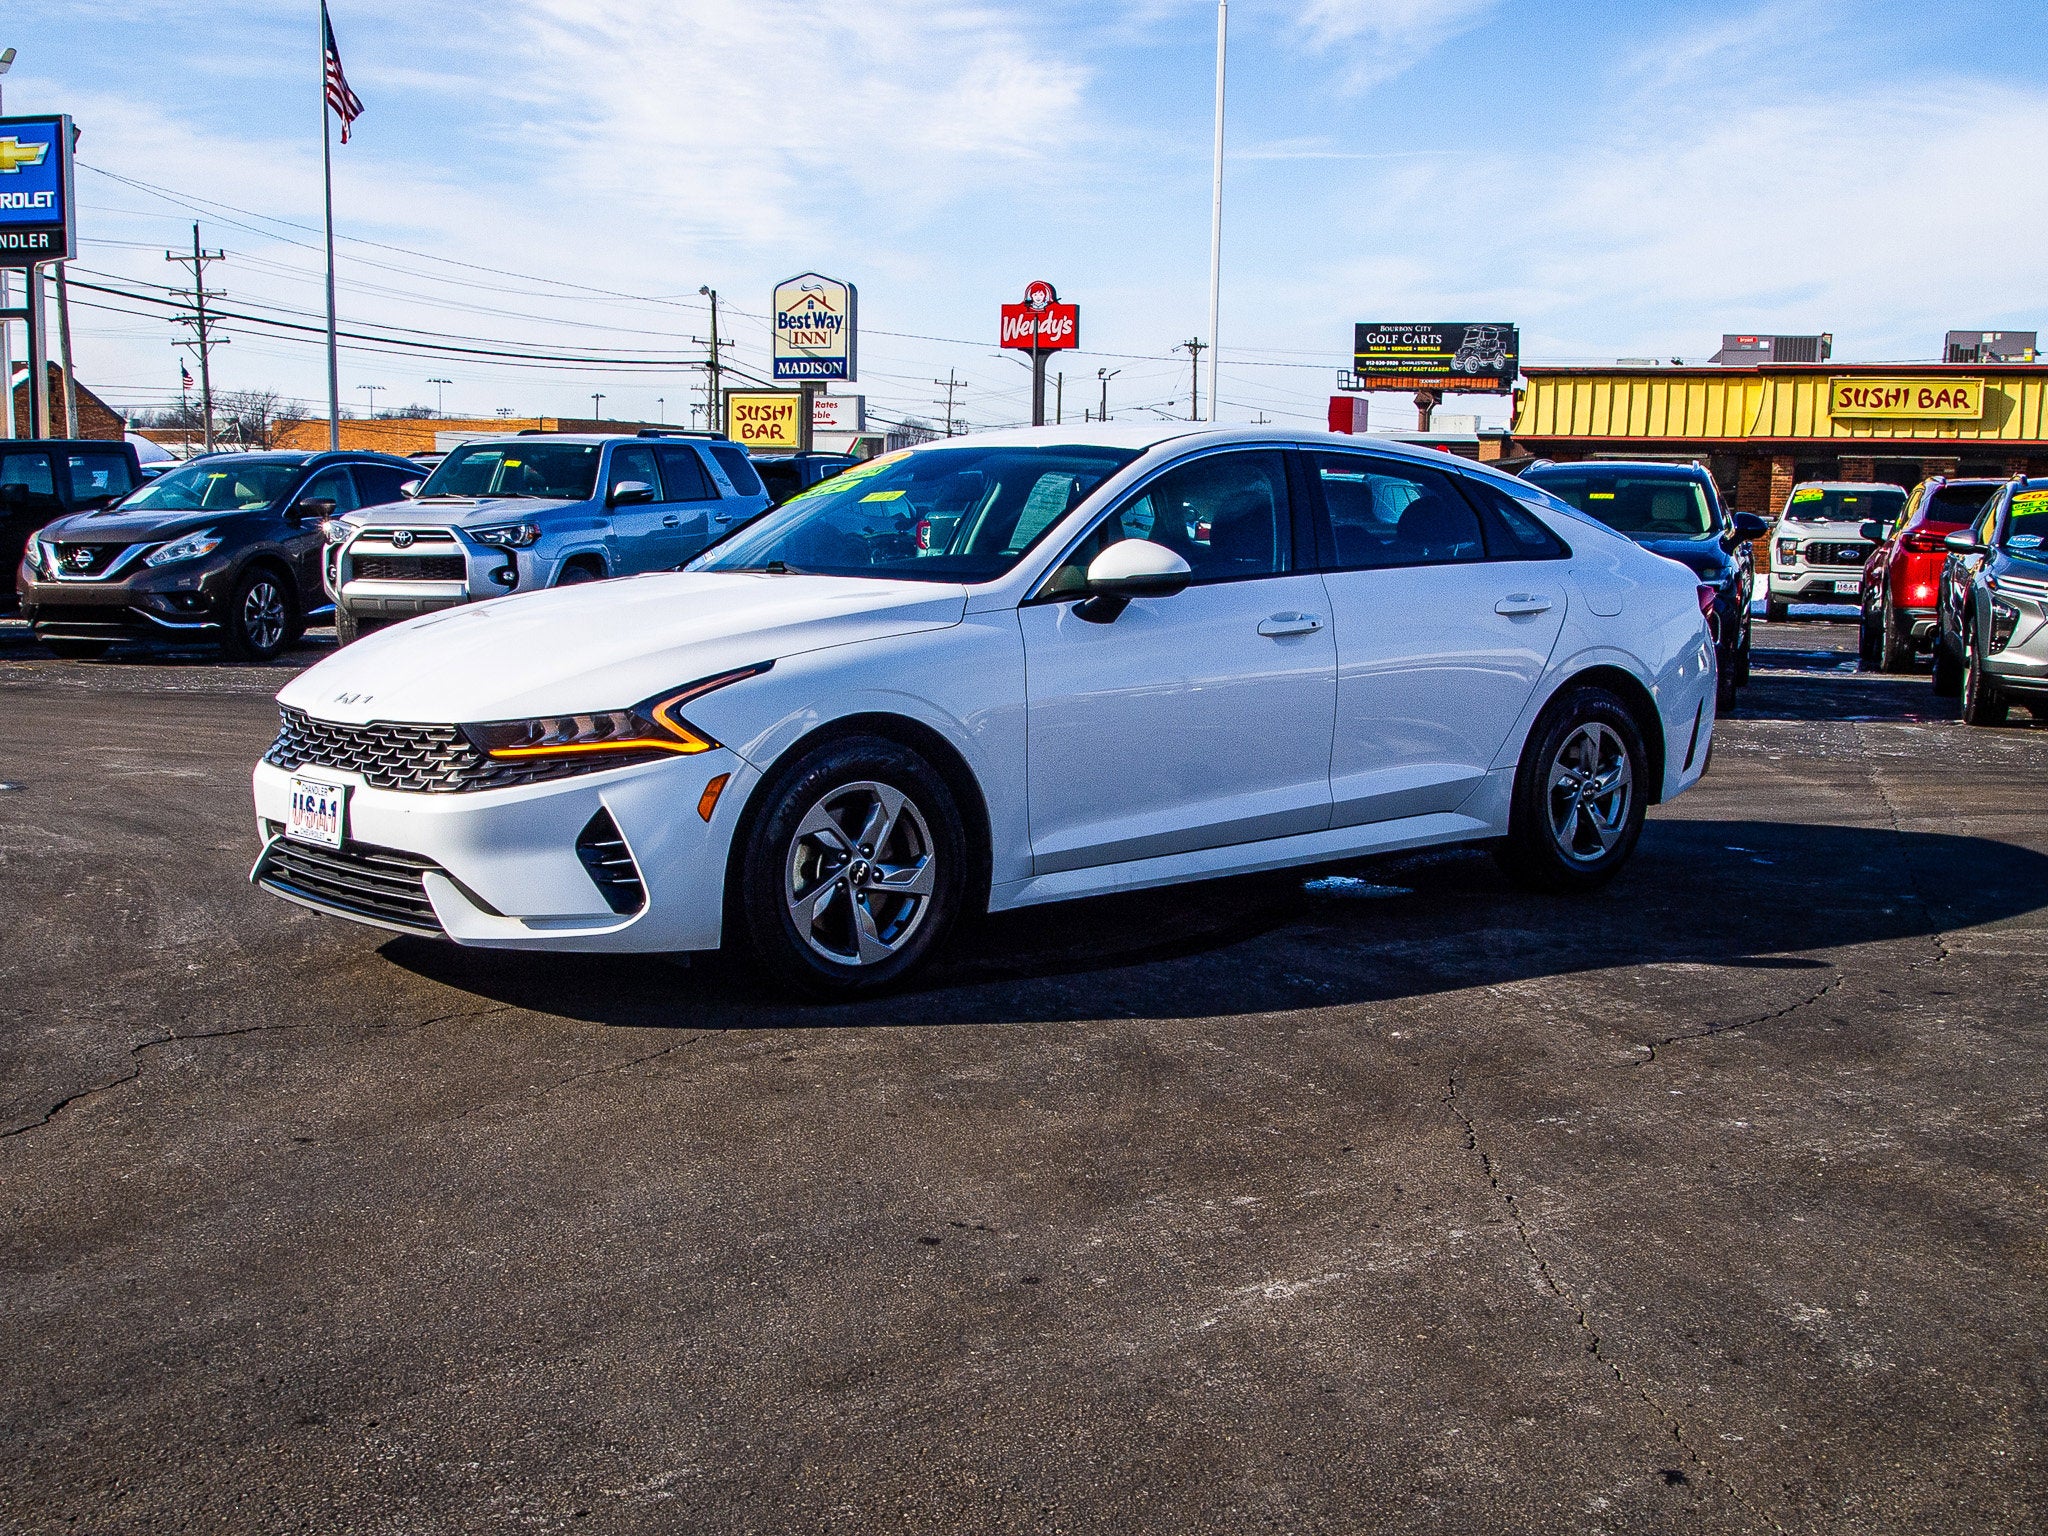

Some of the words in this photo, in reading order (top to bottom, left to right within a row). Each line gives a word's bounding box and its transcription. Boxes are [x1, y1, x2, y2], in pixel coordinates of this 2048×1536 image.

[778, 311, 811, 329] Best
[812, 311, 844, 334] Way
[793, 331, 828, 345] INN
[1366, 333, 1399, 344] GOLF
[1402, 333, 1442, 344] CARTS
[777, 362, 843, 374] MADISON
[815, 400, 839, 409] Rates
[1838, 387, 1910, 409] SUSHI
[1917, 388, 1971, 409] BAR
[735, 405, 793, 421] SUSHI
[741, 423, 785, 439] BAR
